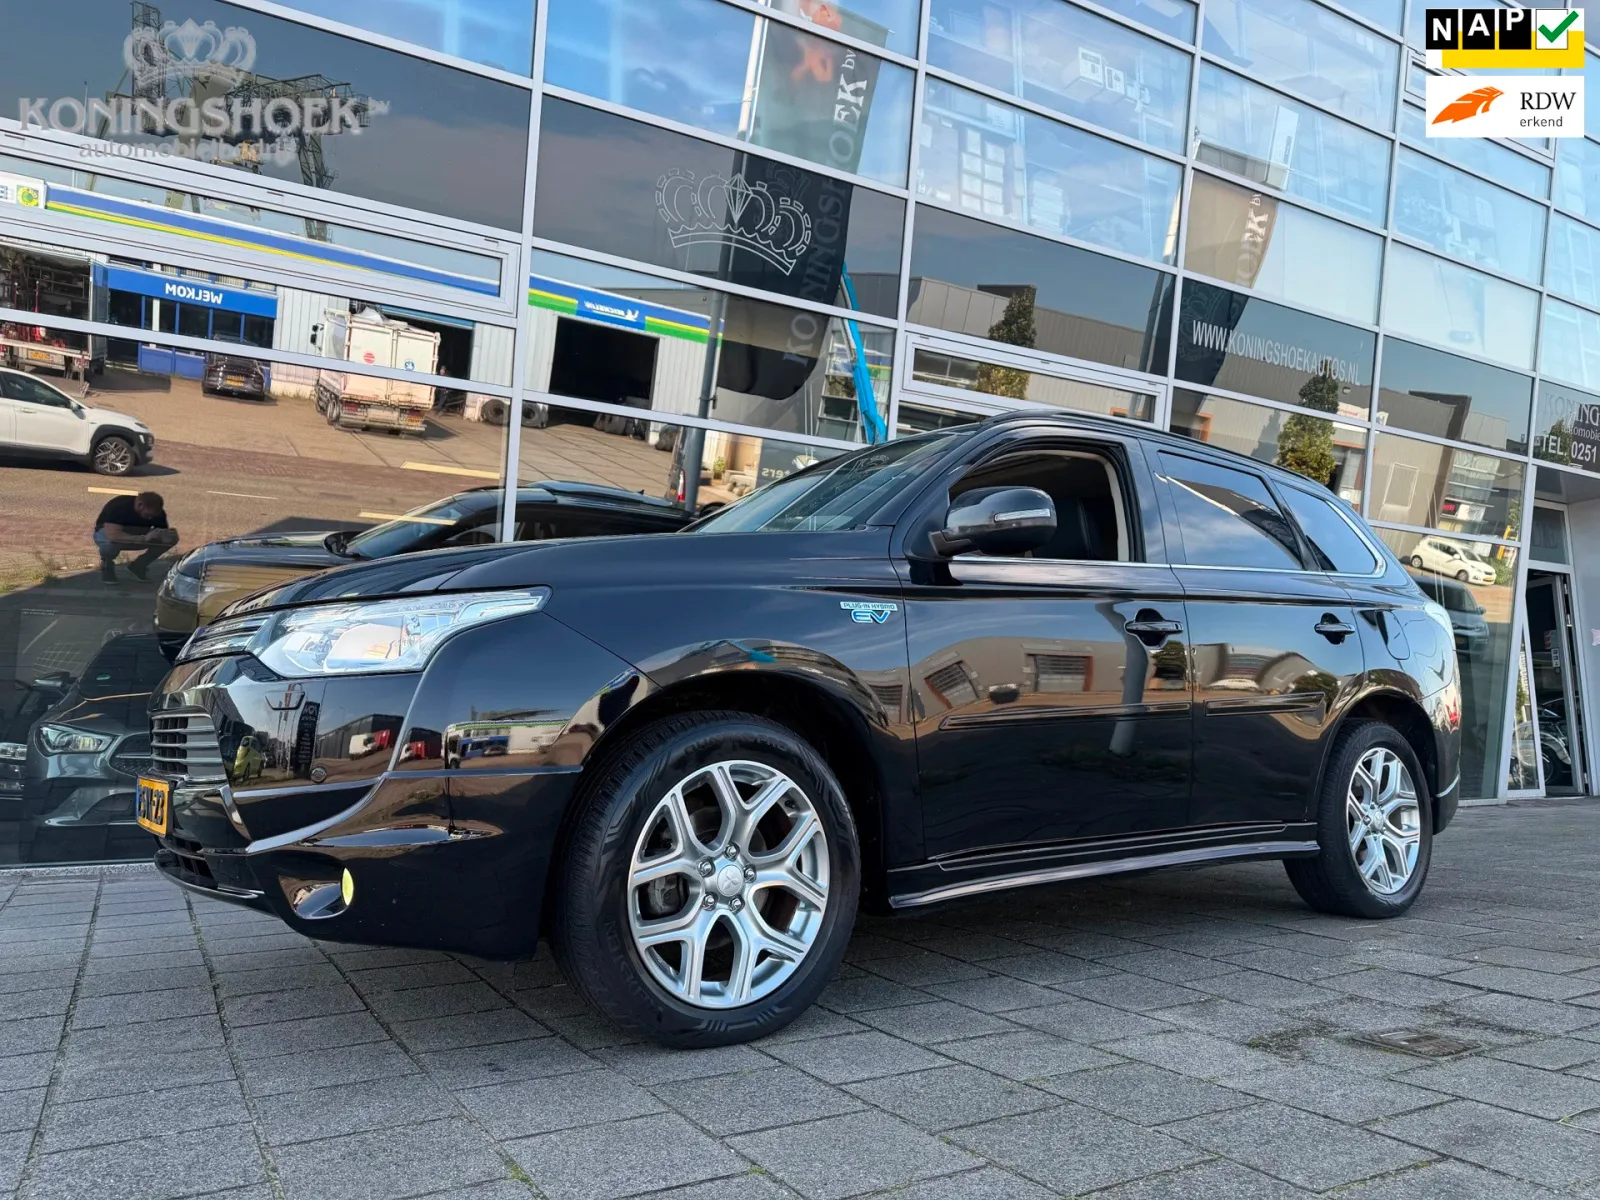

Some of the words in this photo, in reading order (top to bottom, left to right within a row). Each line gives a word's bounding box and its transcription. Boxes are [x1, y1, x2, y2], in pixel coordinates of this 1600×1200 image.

[18, 97, 363, 136] KONINGSHOEK
[1193, 320, 1361, 386] WWW.KONINGSHOEKAUTOS.NL
[1542, 433, 1567, 456] TEL.
[1570, 441, 1597, 463] 0251
[852, 610, 890, 623] EV
